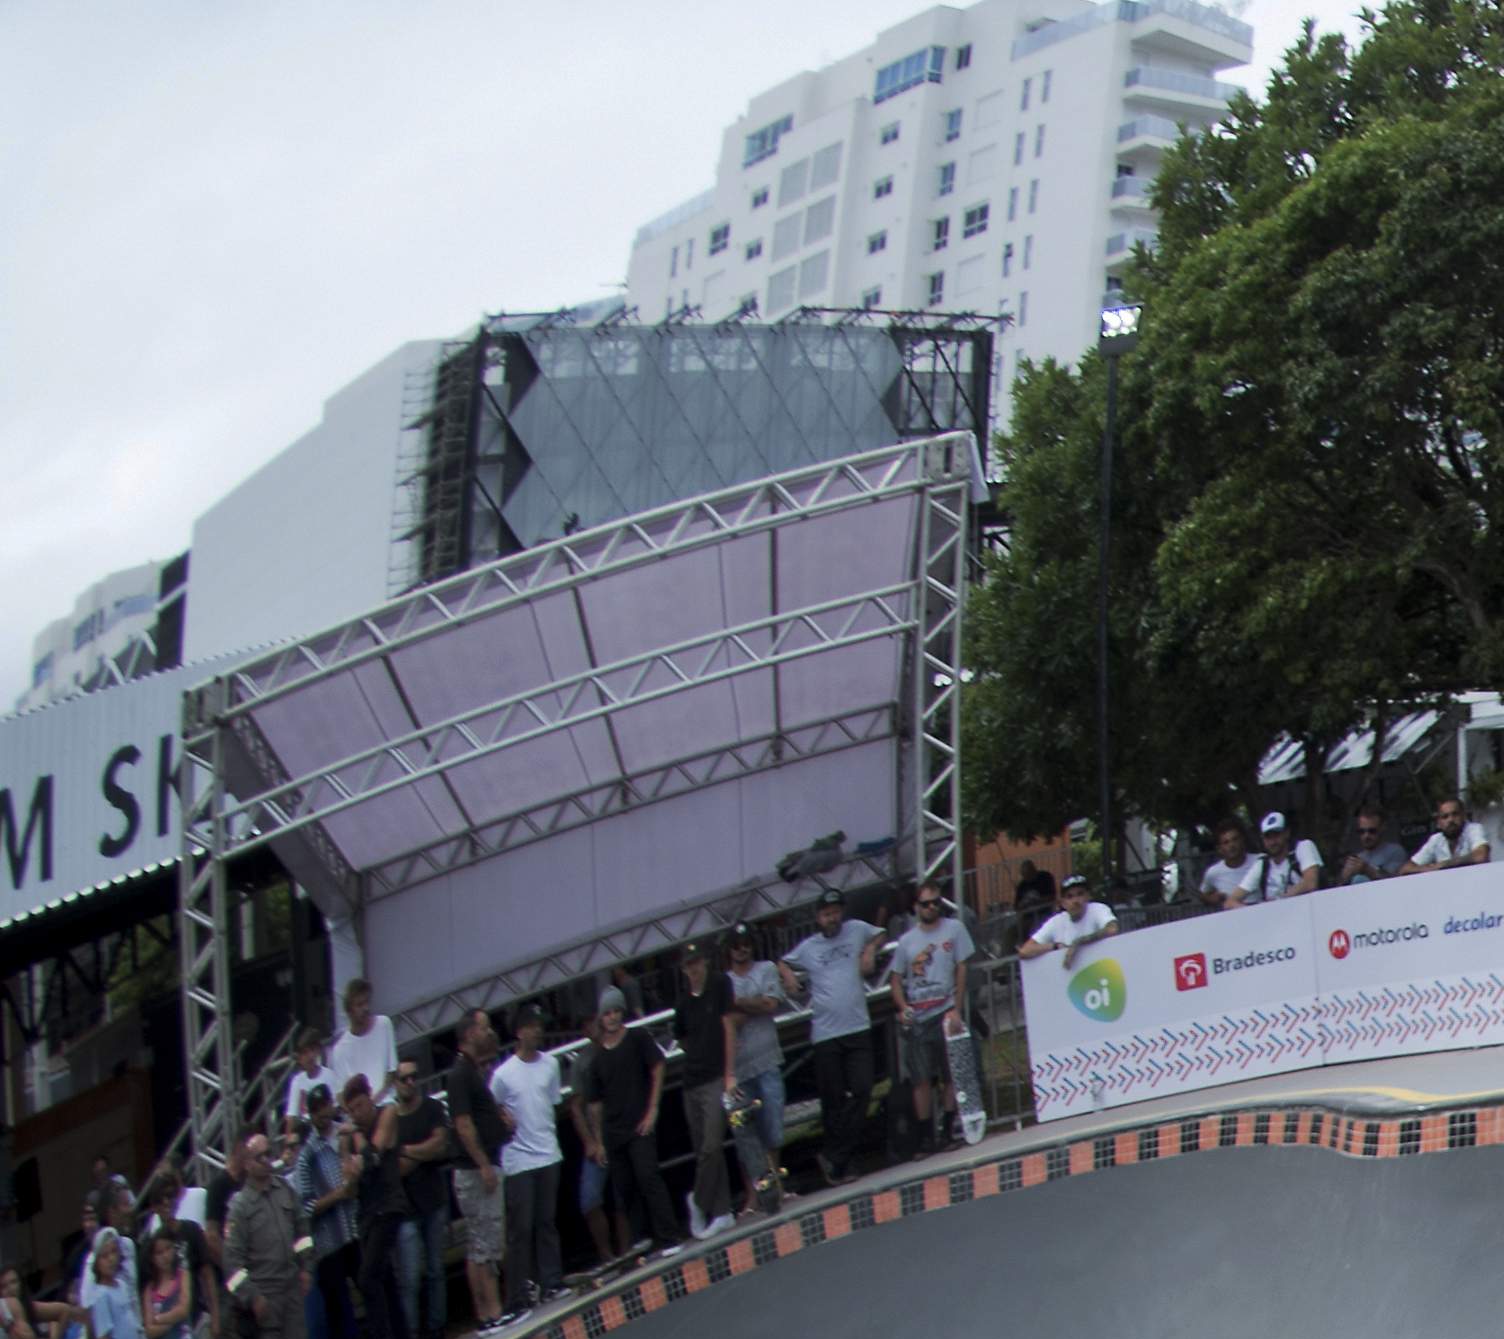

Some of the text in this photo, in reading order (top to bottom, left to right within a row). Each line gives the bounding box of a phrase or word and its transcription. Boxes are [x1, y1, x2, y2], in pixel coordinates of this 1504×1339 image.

[1353, 921, 1429, 948] motorola
[1212, 946, 1296, 975] Bradesco
[1084, 978, 1111, 1010] oi
